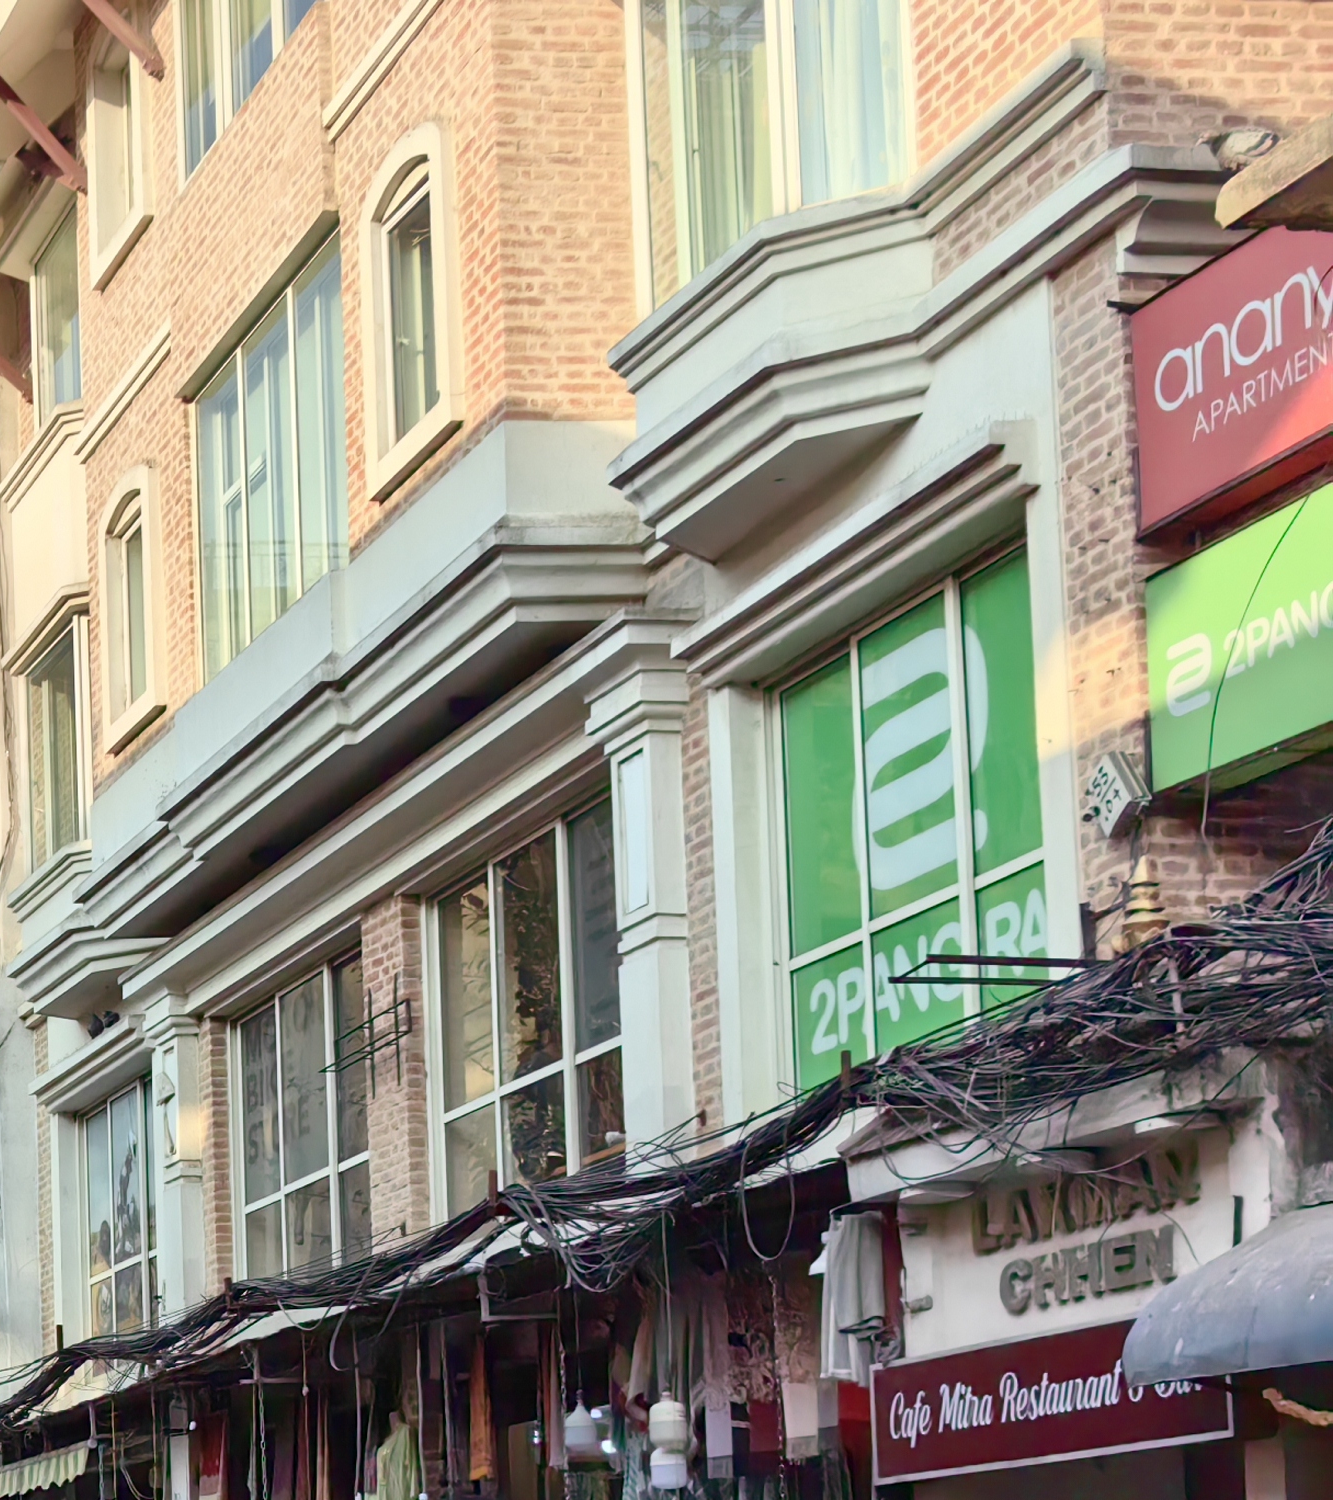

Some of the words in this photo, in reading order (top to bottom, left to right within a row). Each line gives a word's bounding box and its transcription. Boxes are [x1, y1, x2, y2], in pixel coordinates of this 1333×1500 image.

[1192, 332, 1333, 442] APARTMEN
[890, 1386, 932, 1449] Cafe
[938, 1381, 994, 1434] Mitra
[999, 1357, 1123, 1424] Restaurant
